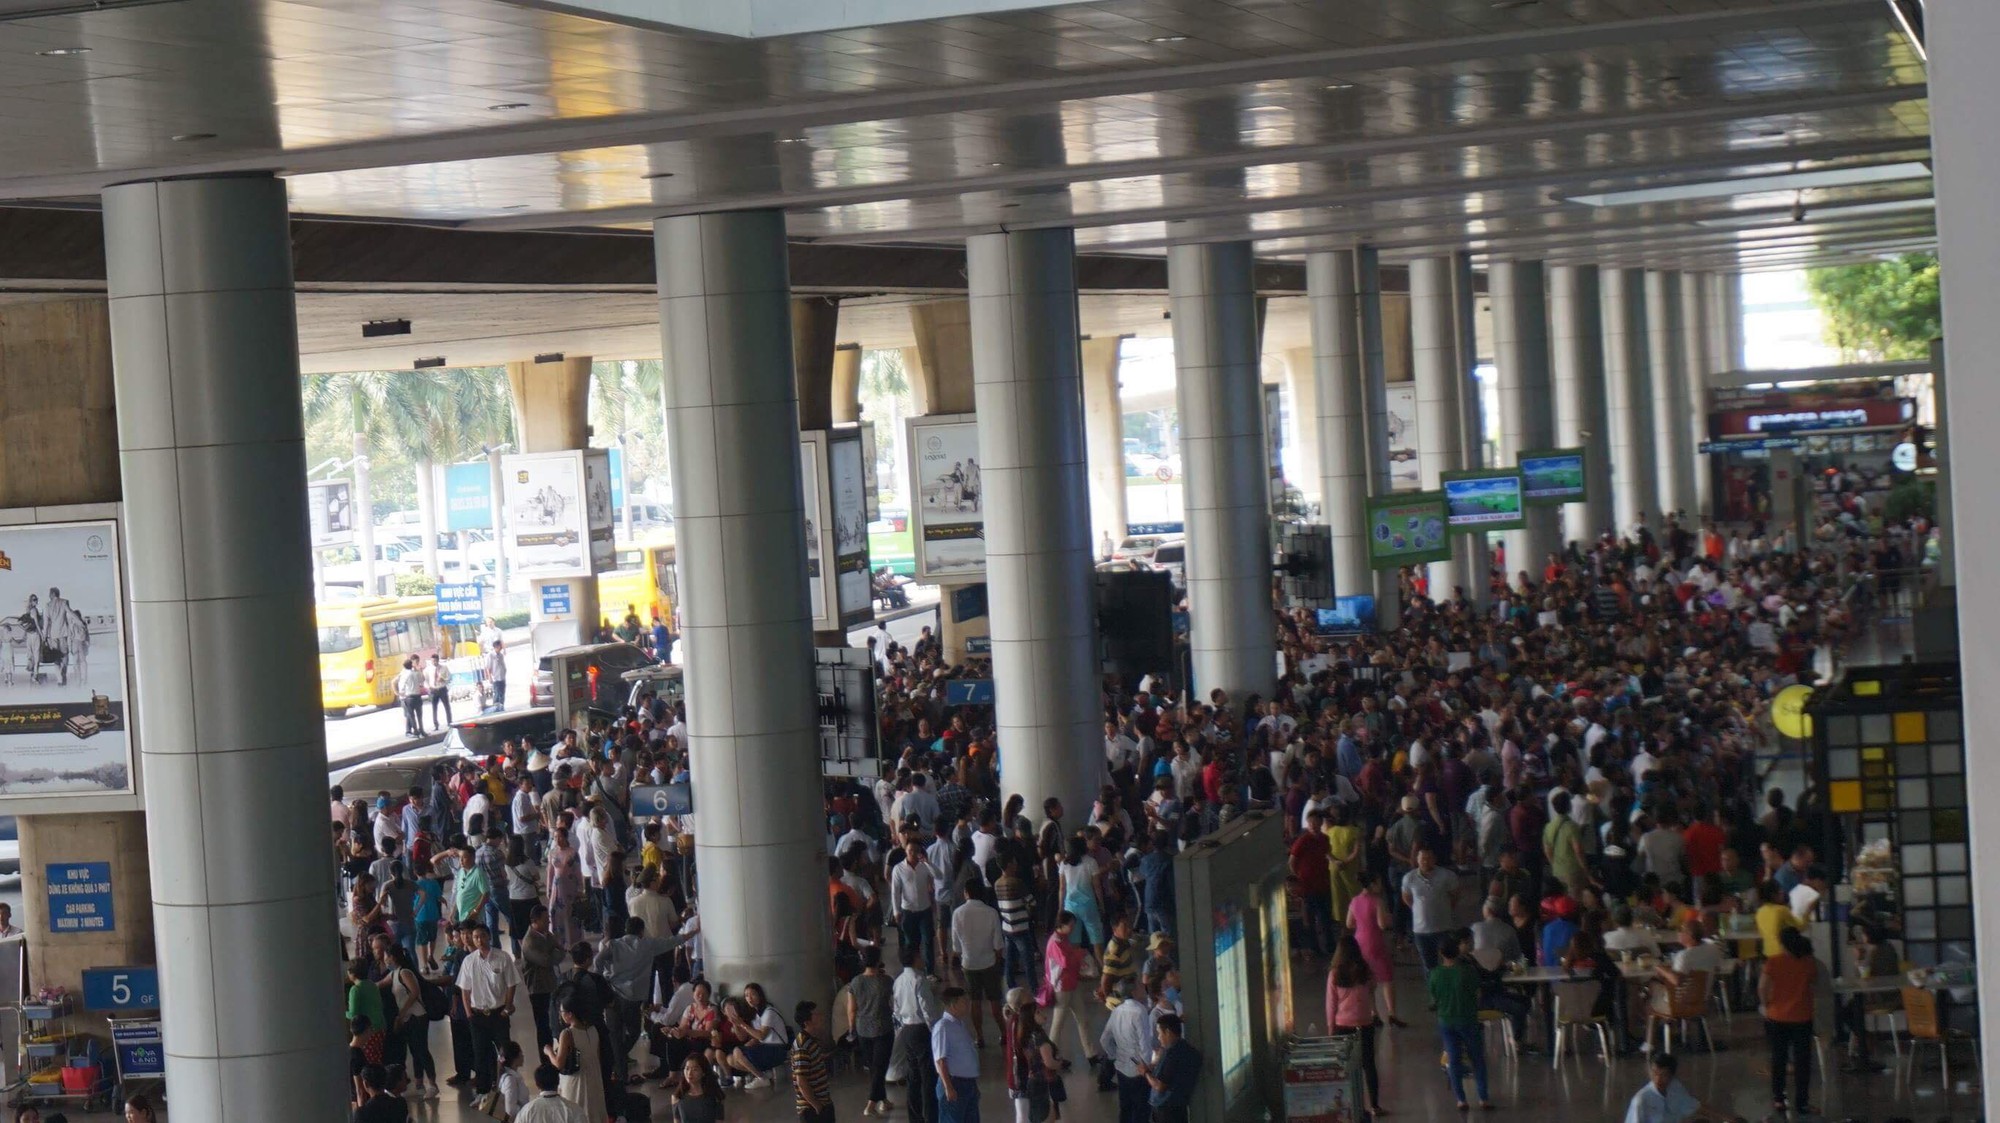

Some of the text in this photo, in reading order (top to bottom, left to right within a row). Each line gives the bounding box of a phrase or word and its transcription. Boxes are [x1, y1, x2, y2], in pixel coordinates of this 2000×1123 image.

[963, 683, 976, 701] 7
[654, 790, 668, 811] 6
[67, 867, 90, 881] KHU VỰC
[61, 884, 68, 895] XE
[68, 881, 84, 894] KHÔNG
[65, 903, 96, 914] CAR PARKING
[57, 918, 79, 928] MAXIMUM
[84, 916, 104, 927] MINUTES
[112, 974, 155, 1004] 5 GF
